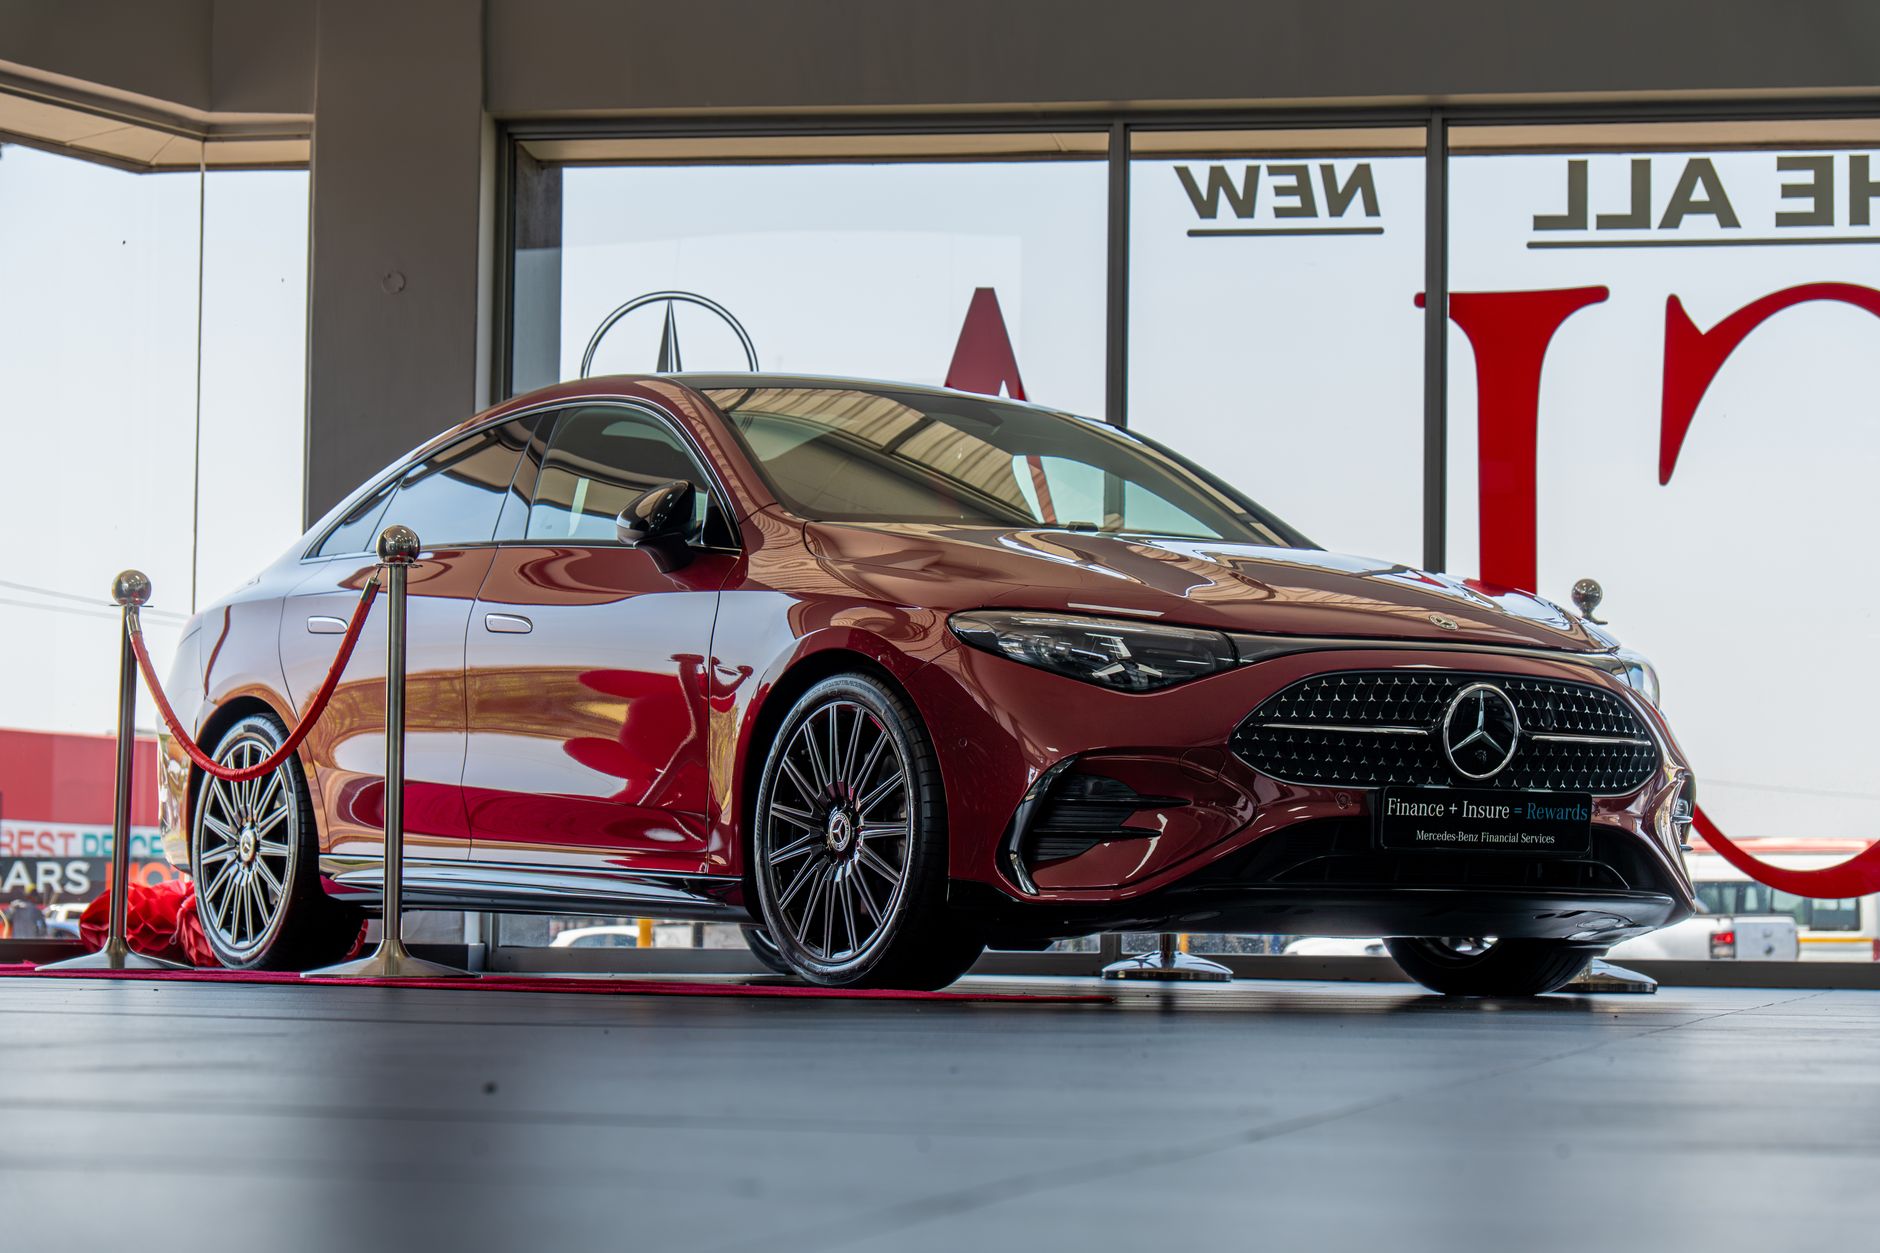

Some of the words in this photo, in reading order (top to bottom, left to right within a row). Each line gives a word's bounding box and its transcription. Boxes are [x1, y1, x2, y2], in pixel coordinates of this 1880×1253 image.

[1387, 797, 1445, 817] Finance
[1462, 800, 1510, 819] Insure
[1526, 802, 1588, 820] Rewards
[1416, 830, 1479, 842] Mercedes-Benz
[1481, 832, 1519, 843] Financial
[1520, 832, 1556, 844] Services
[0, 859, 91, 895] ARS
